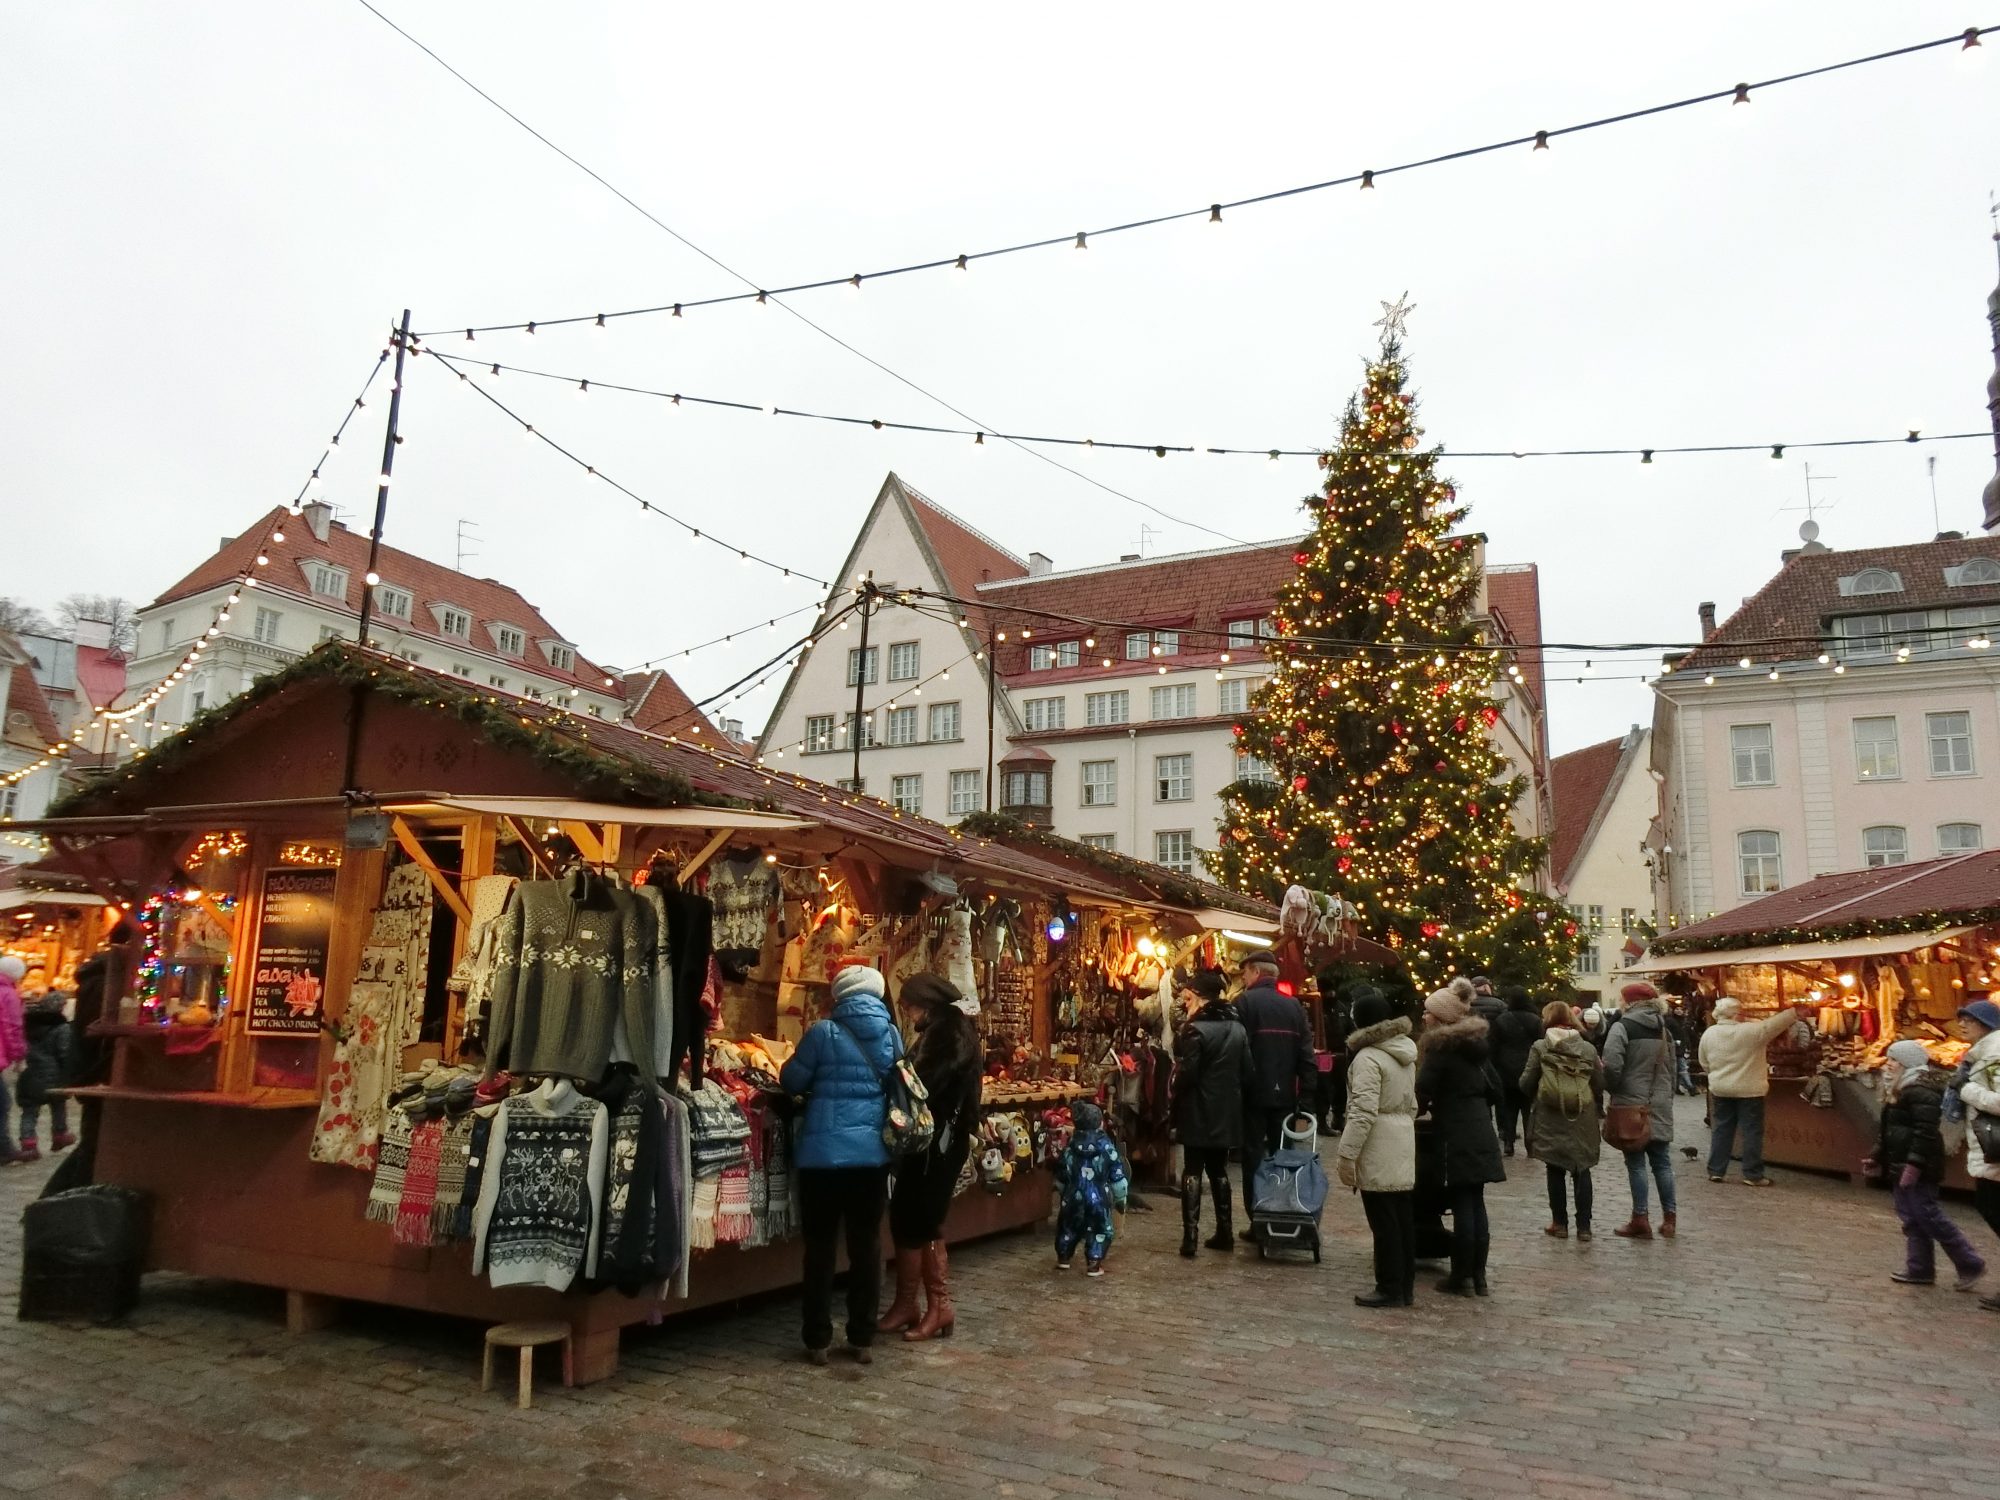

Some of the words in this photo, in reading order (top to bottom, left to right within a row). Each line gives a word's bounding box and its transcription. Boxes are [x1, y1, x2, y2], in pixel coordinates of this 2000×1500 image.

[255, 997, 268, 1006] TEA
[253, 1008, 278, 1017] KAKAO
[252, 1018, 268, 1028] HOT
[268, 1019, 295, 1028] CHOCO
[295, 1020, 319, 1029] DRINK
